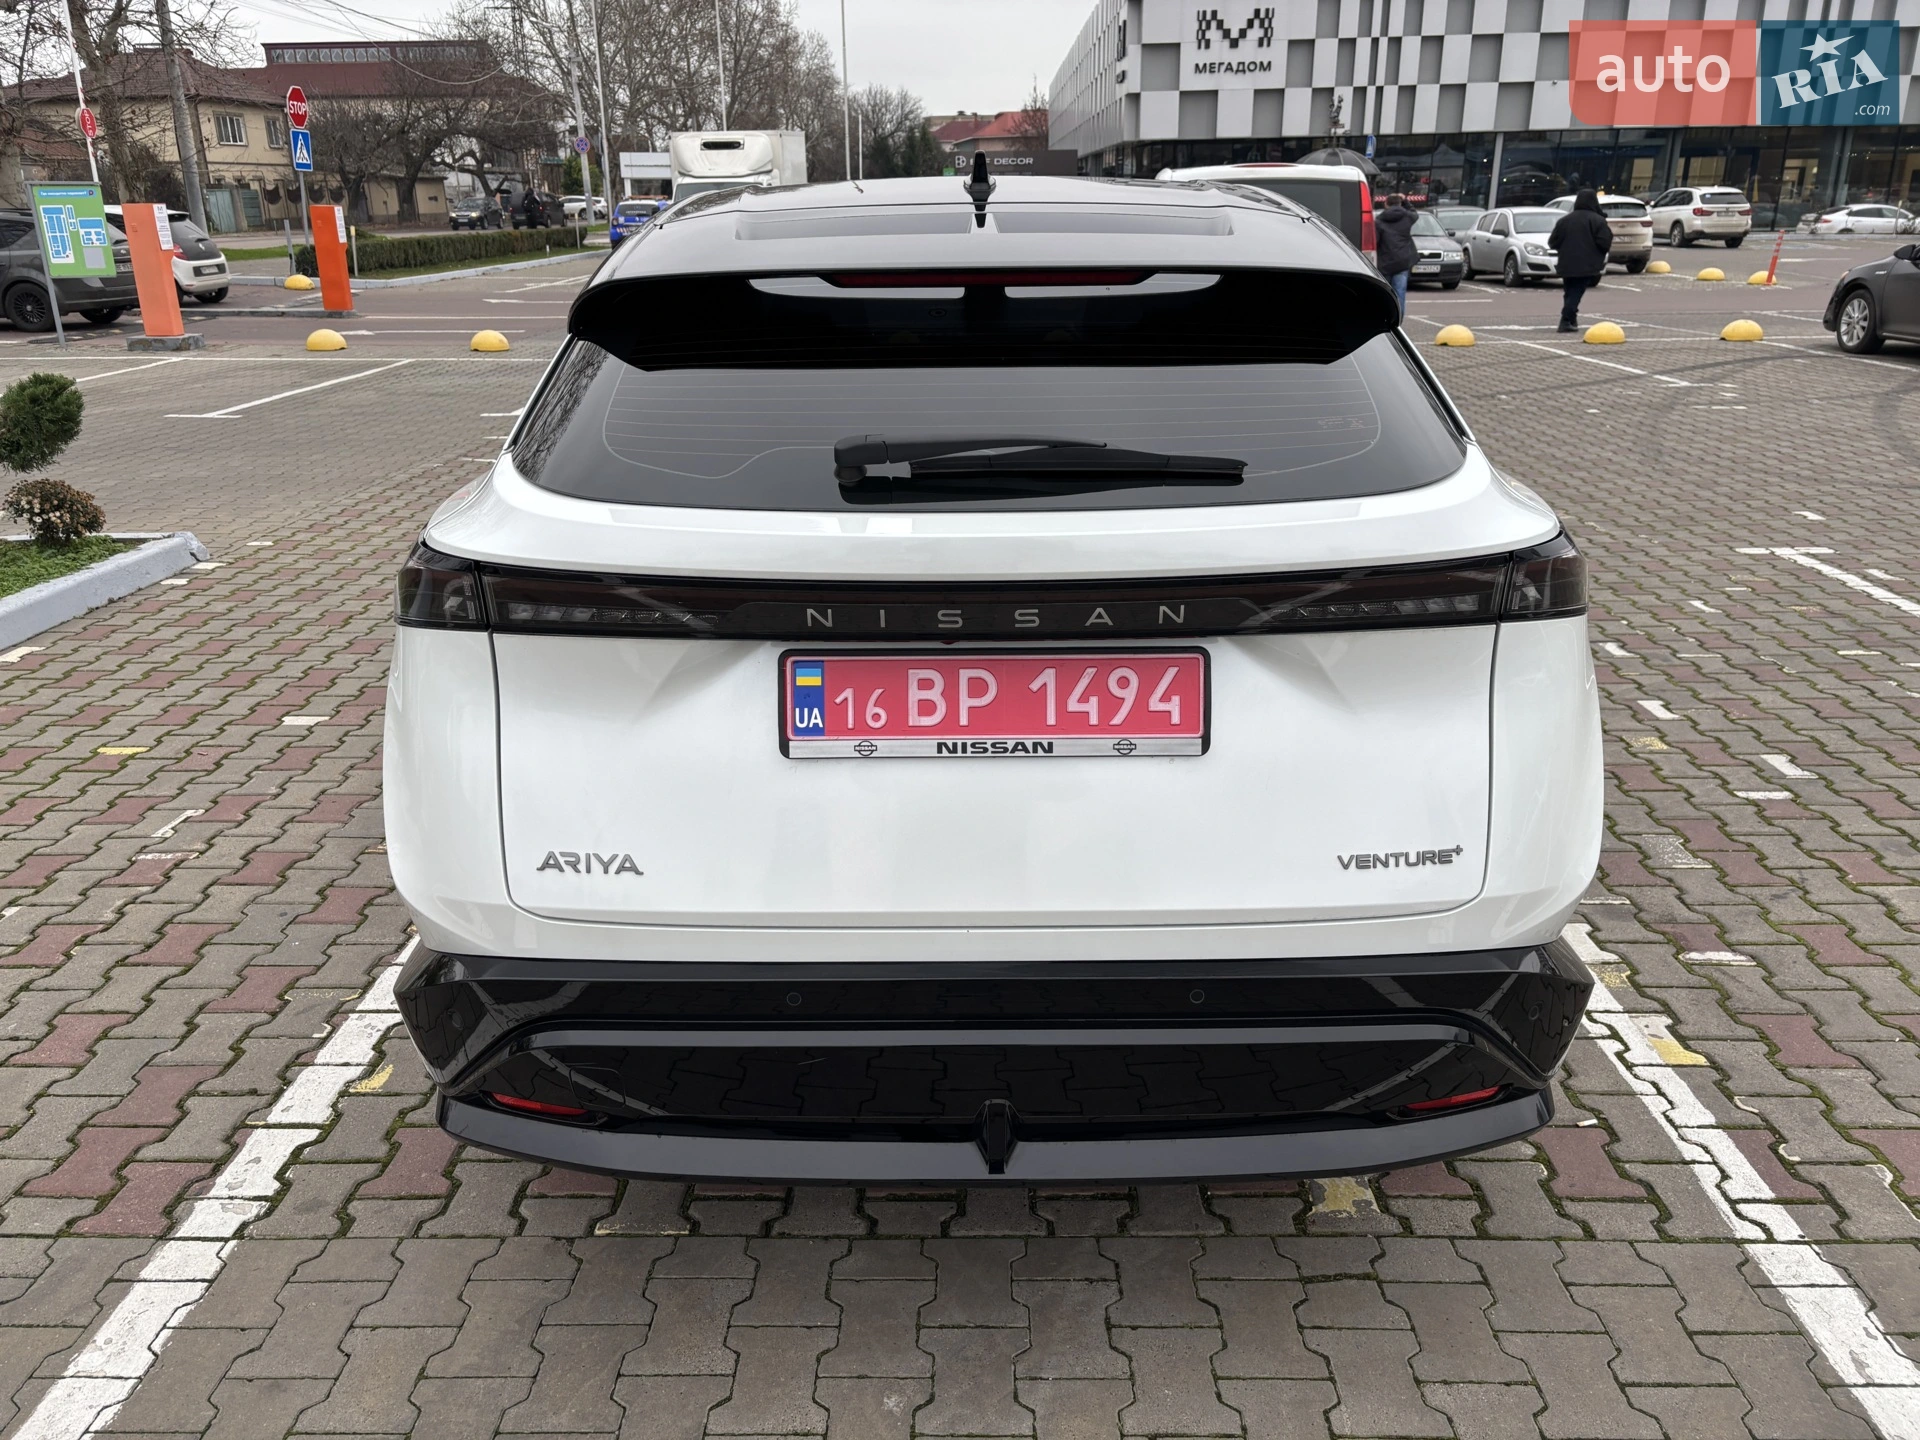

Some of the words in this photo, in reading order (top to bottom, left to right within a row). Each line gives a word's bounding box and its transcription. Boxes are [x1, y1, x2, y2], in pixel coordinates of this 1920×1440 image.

[1194, 61, 1272, 75] МЕГАДОМ
[289, 101, 307, 115] STOP
[83, 110, 94, 137] STOP
[806, 604, 1186, 629] NISSAN
[833, 687, 888, 730] 16
[907, 667, 999, 728] BP
[1028, 666, 1182, 727] 1494
[795, 707, 824, 729] UA
[936, 741, 1055, 755] NISSAN
[536, 851, 645, 876] ARIYA
